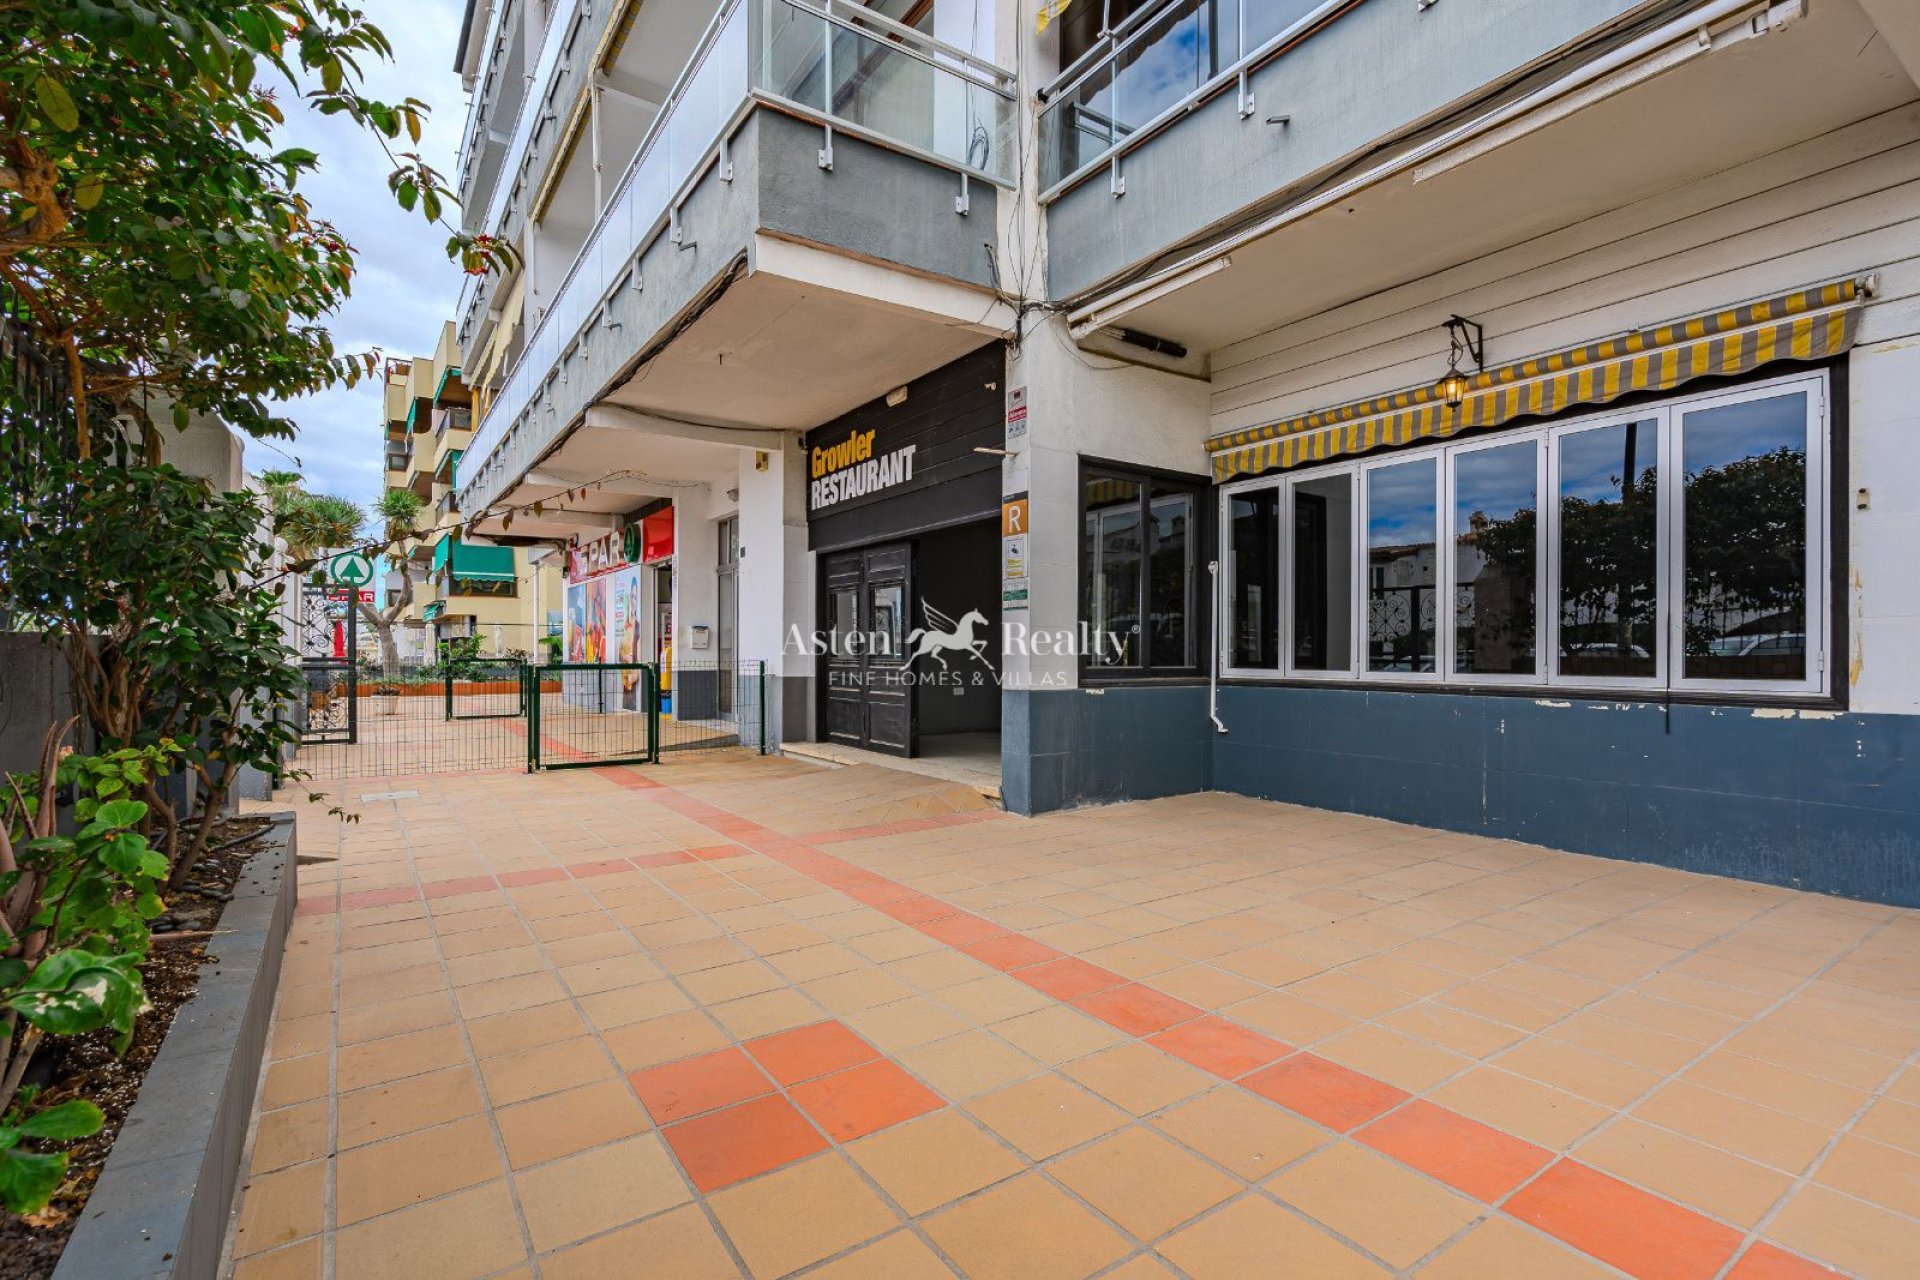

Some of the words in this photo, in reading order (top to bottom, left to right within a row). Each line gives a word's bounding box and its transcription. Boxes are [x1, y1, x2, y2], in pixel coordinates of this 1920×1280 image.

[812, 429, 875, 479] Growler
[812, 444, 916, 511] RESTAURANT
[1009, 505, 1021, 533] R
